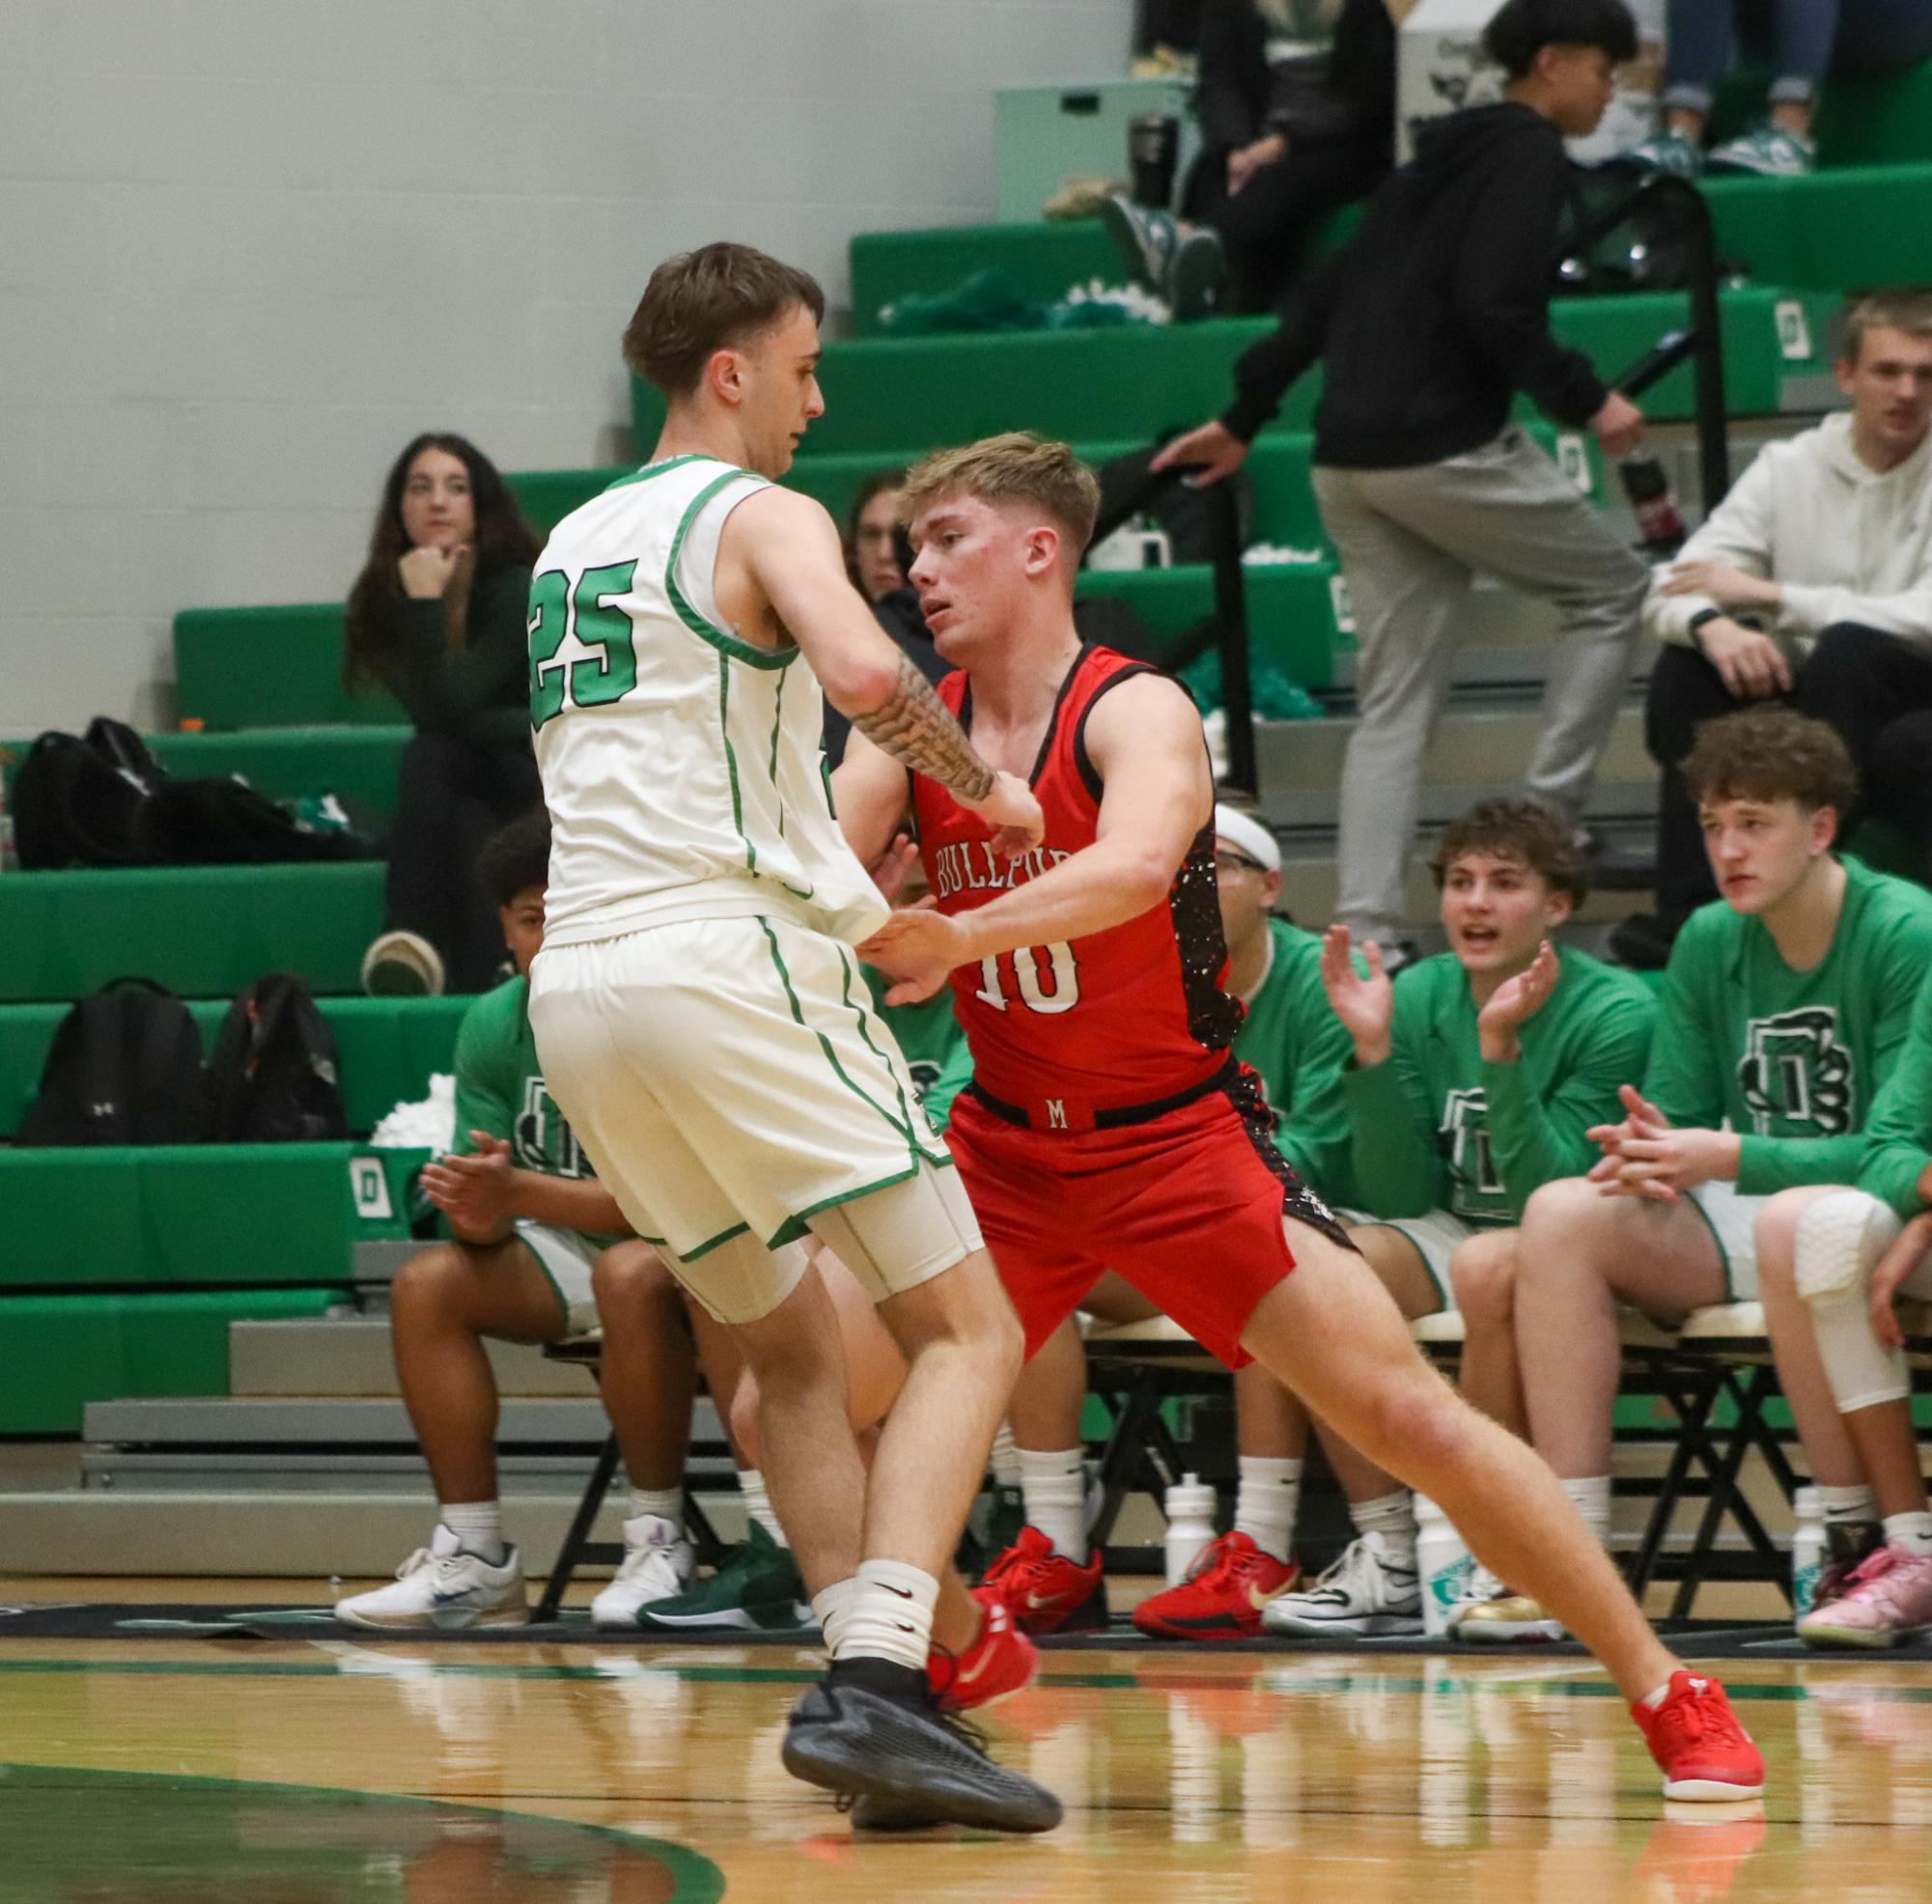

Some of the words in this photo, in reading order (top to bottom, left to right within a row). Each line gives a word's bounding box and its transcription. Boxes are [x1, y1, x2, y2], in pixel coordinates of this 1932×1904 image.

[528, 558, 639, 734] 25
[975, 940, 1080, 1014] 10
[1045, 1099, 1068, 1129] M
